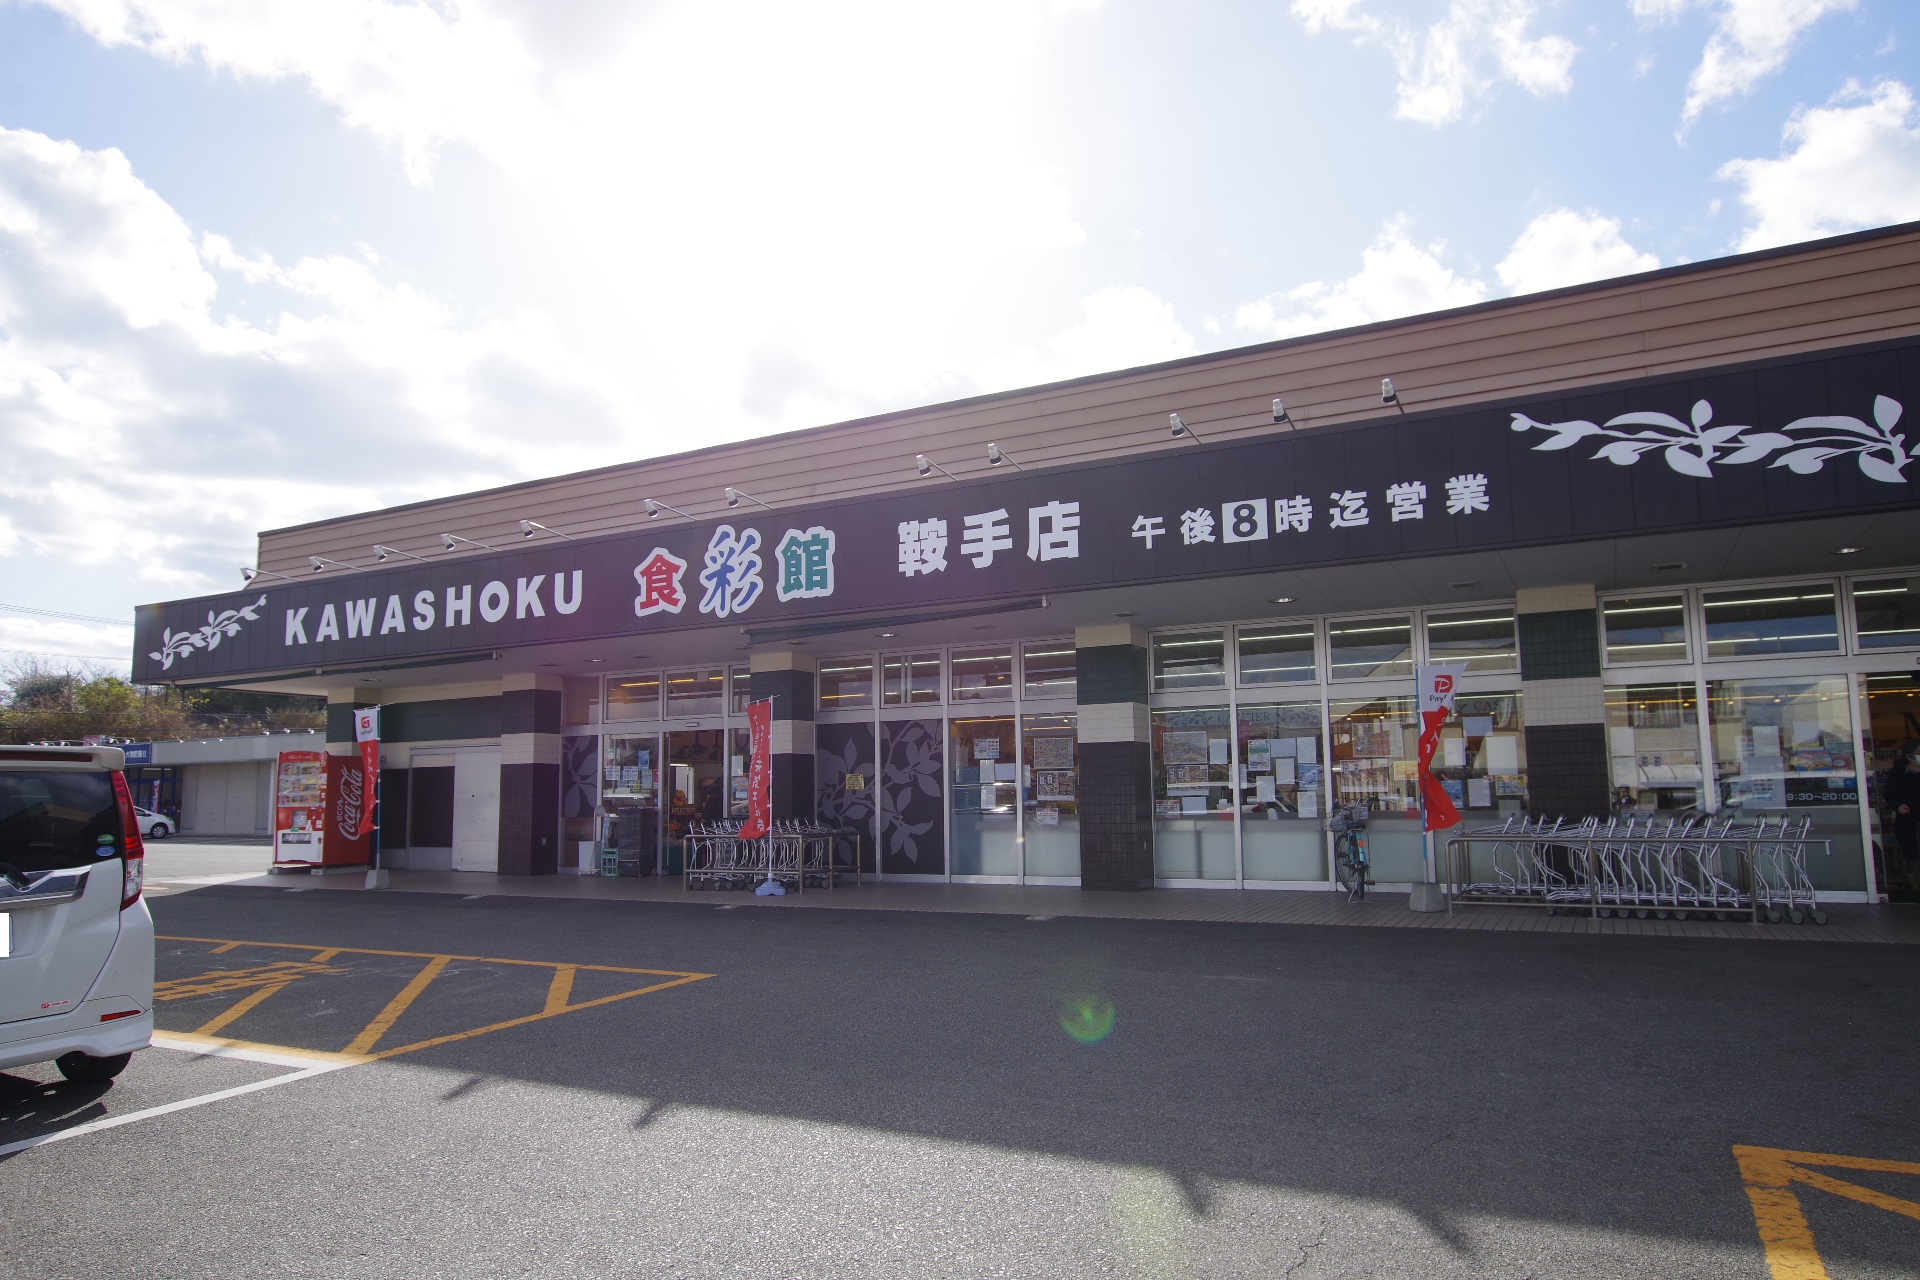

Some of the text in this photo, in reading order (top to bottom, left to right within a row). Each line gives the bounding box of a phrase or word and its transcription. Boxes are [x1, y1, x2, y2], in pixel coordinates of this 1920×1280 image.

[1131, 474, 1490, 550] 午後8時迄営業
[633, 501, 1081, 618] 食彩館 鞍手店
[285, 569, 584, 646] KAWASHOKU
[1218, 711, 1270, 722] CIER
[1429, 694, 1454, 704] PayP
[339, 764, 363, 840] Coca-Cola
